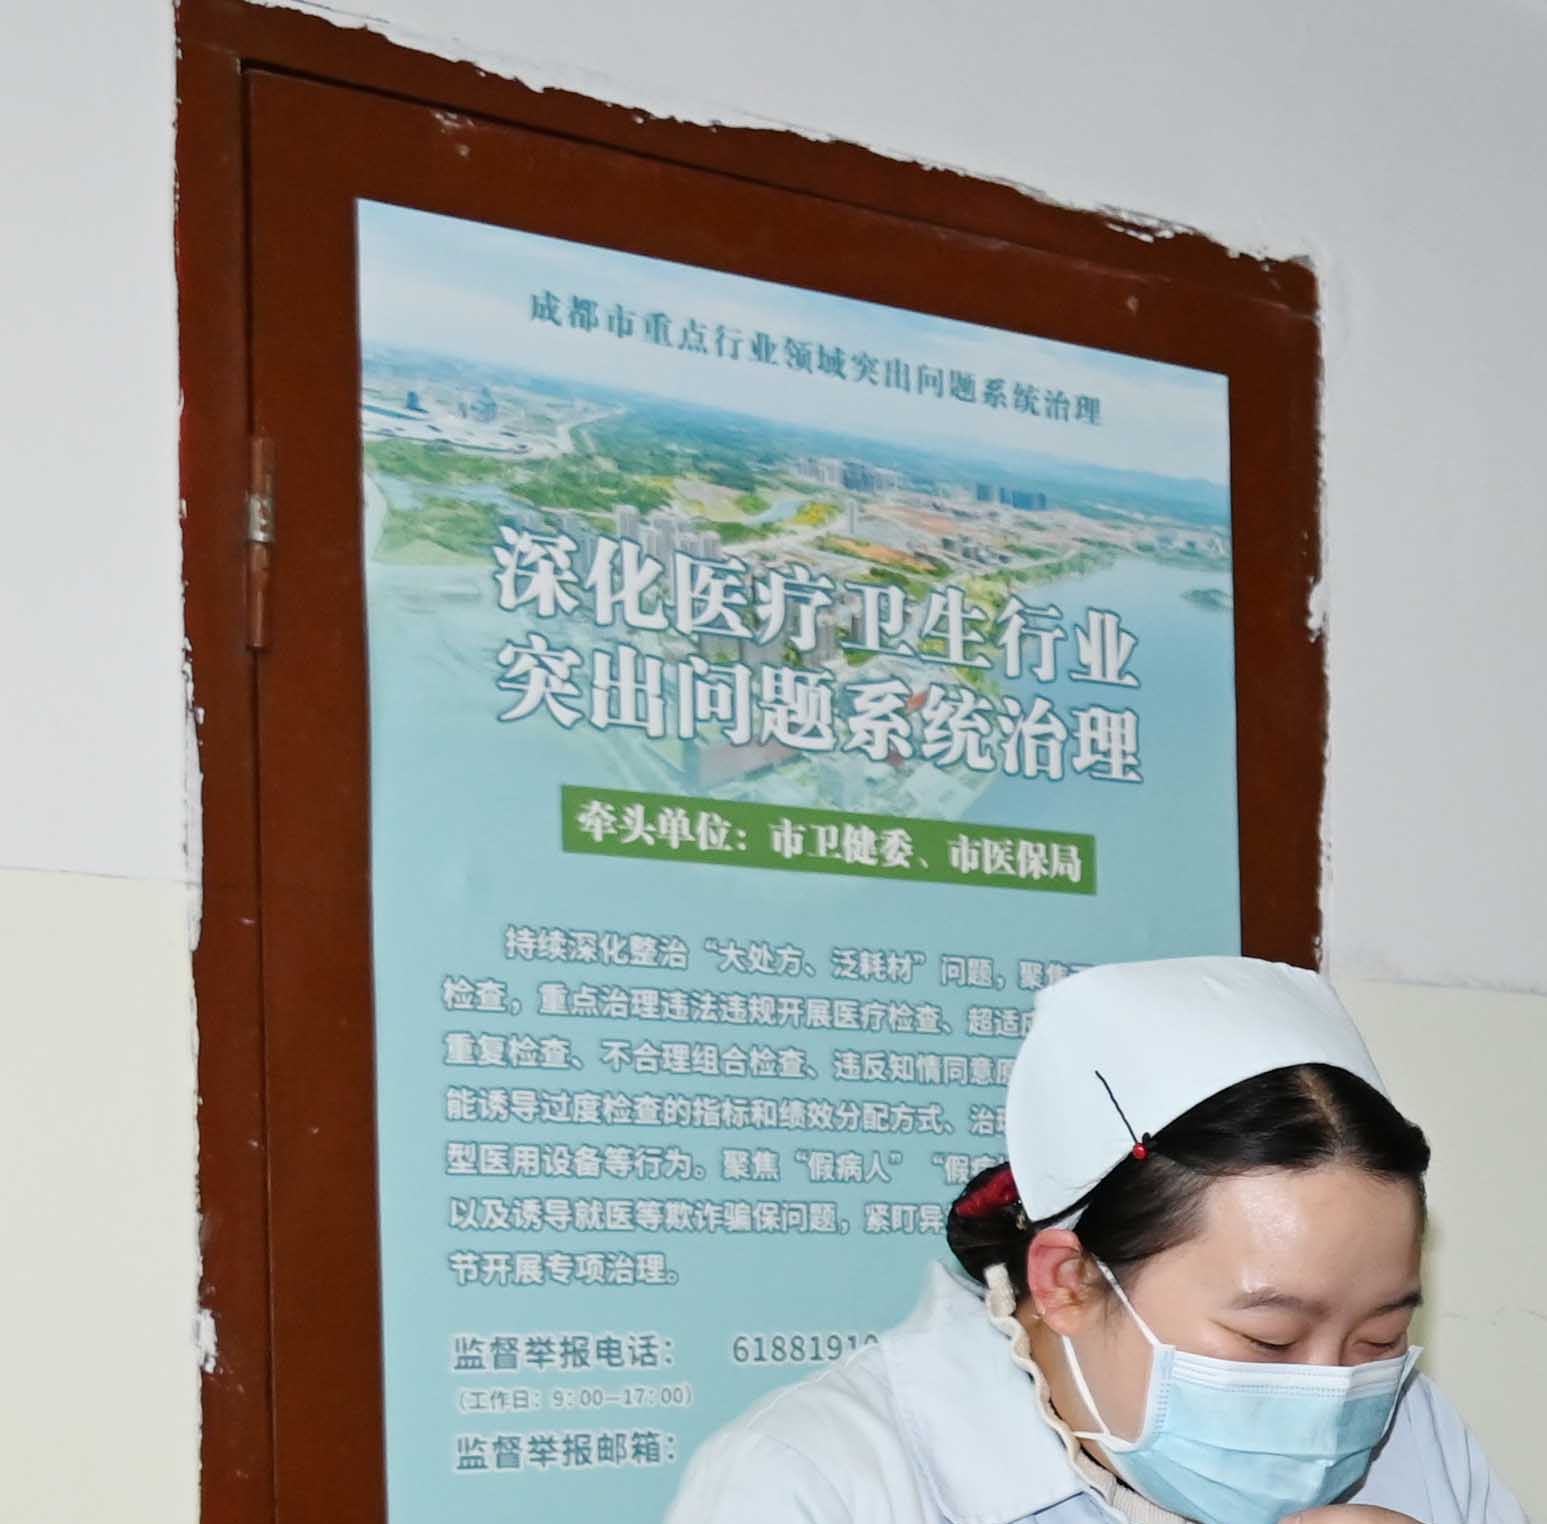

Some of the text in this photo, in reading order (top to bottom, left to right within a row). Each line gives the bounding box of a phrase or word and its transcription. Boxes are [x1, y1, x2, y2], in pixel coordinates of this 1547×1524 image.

[530, 289, 1103, 426] 成都市重点行业领域突出问题系统治理
[493, 524, 1142, 689] 深化医疗卫生行业
[494, 632, 1145, 785] 突出问题系统治理
[449, 1249, 680, 1286] 节开展专项治理。
[453, 1334, 673, 1371] 监督举报电话：
[456, 1431, 676, 1471] 监督举报邮箱：
